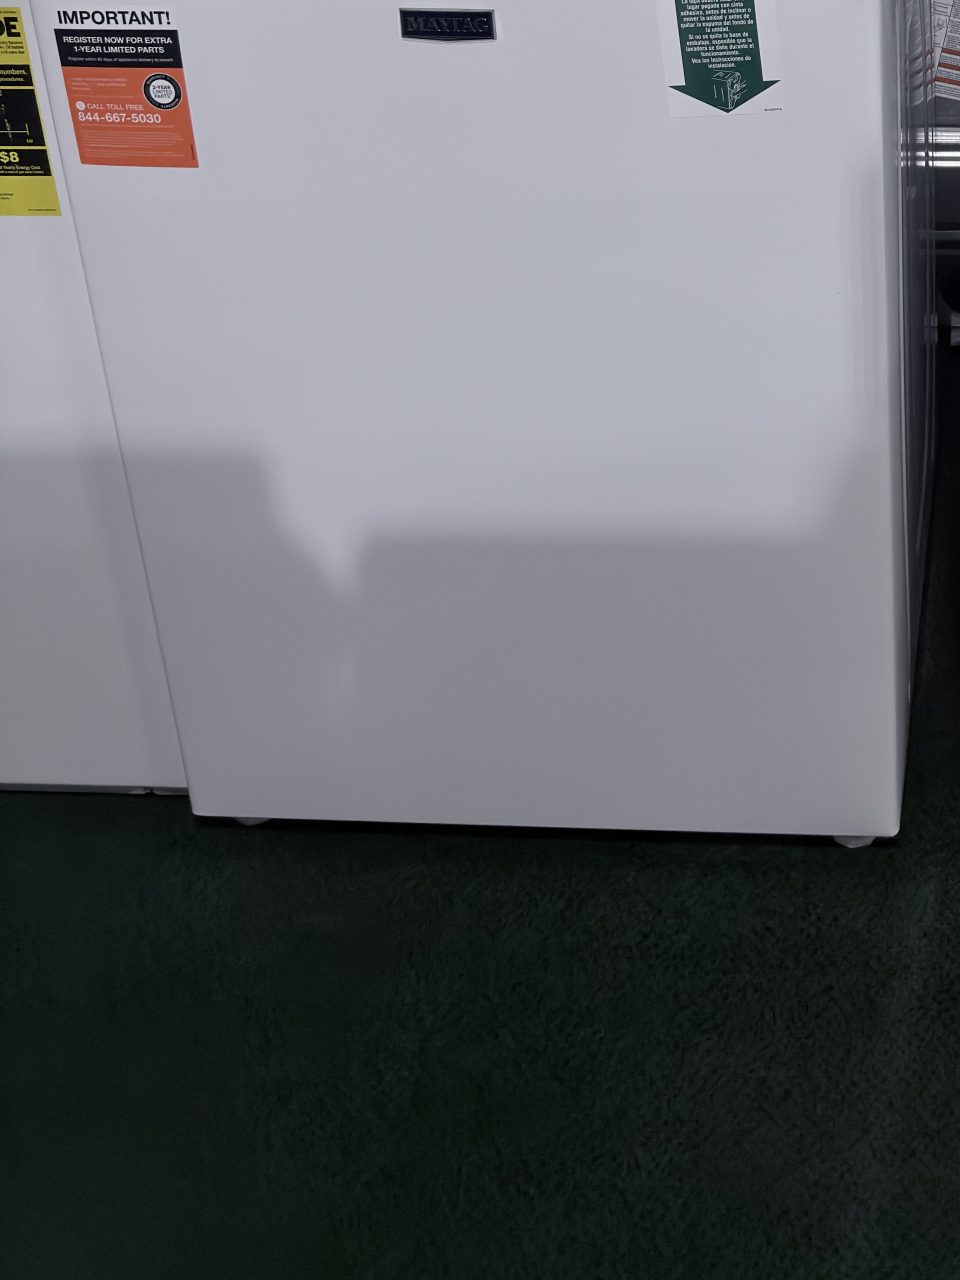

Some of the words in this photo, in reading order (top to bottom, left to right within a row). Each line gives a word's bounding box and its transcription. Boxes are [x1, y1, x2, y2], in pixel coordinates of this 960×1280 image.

[57, 10, 171, 25] IMPORTANT!
[406, 16, 489, 32] MAYTAG
[62, 35, 104, 44] REGISTER
[104, 36, 125, 44] NOW
[126, 36, 144, 44] FOR
[144, 36, 173, 44] EXTRA
[73, 45, 102, 53] 1-YEAR
[137, 46, 165, 54] PARTS
[87, 103, 105, 111] CALL
[78, 111, 162, 124] 844-667-5030
[0, 151, 20, 163] $8
